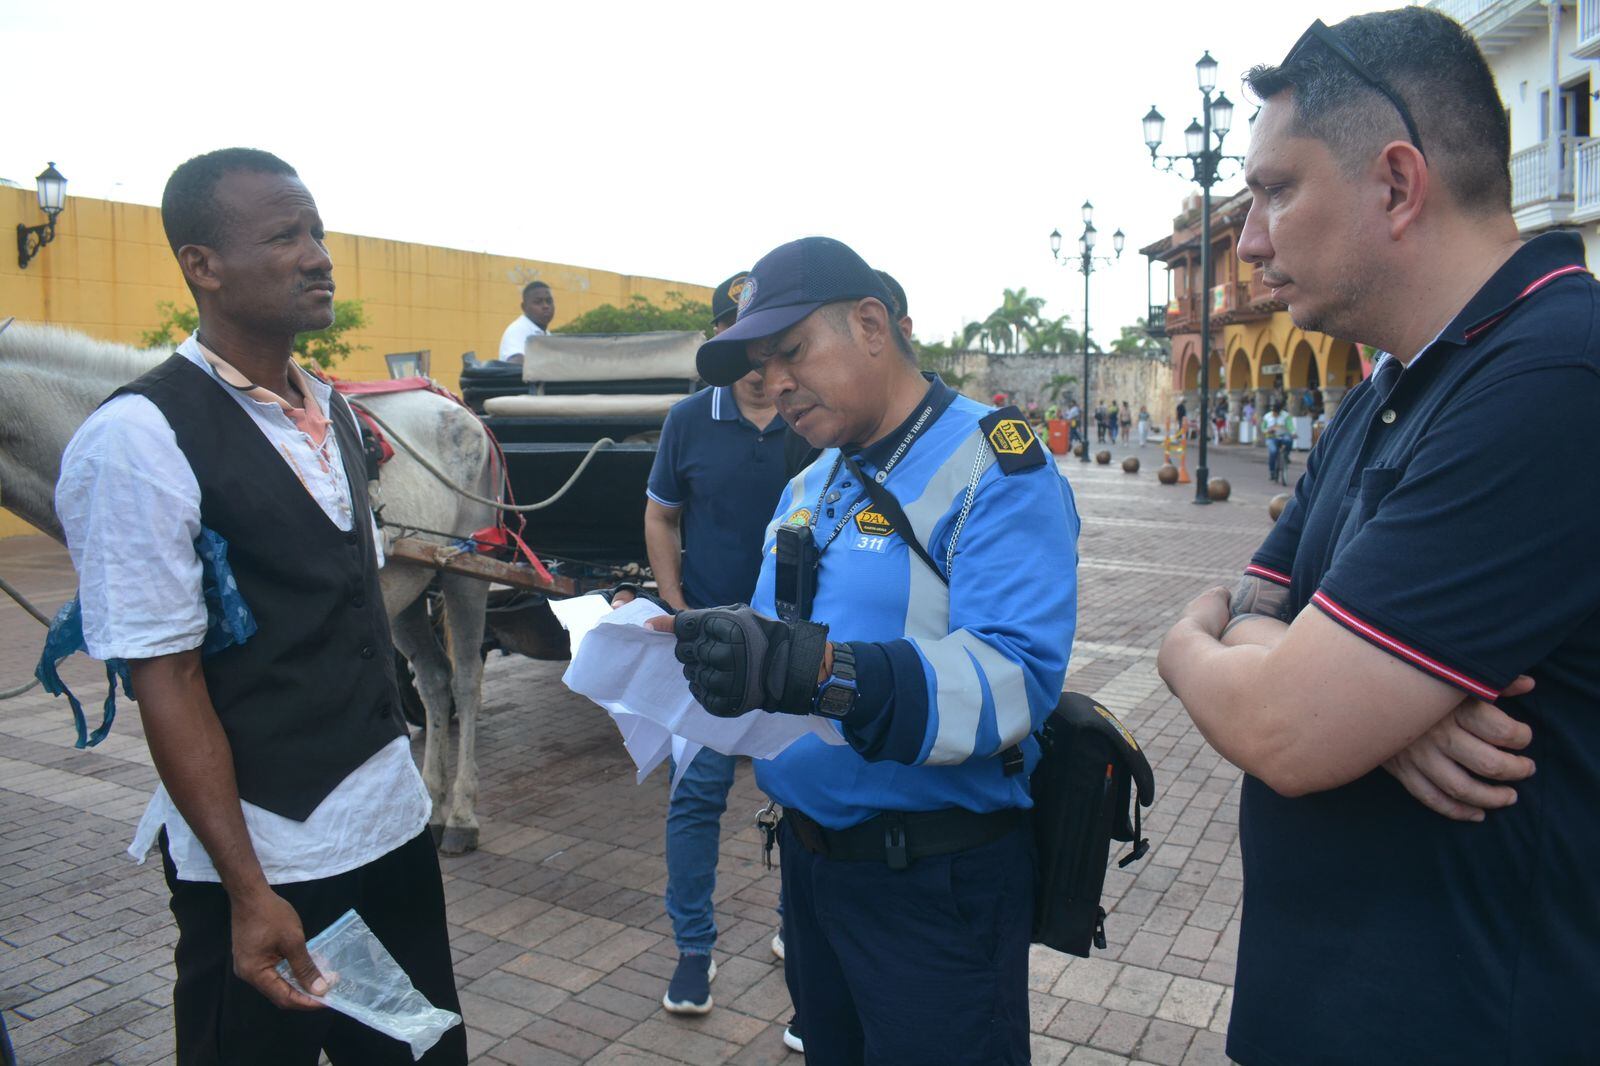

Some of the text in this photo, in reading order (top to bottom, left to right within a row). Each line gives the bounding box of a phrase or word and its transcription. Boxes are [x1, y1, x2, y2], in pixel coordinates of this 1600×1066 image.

[884, 406, 932, 472] AGENTES DE TRANSITO
[1001, 422, 1024, 450] DATT
[857, 537, 884, 550] 311
